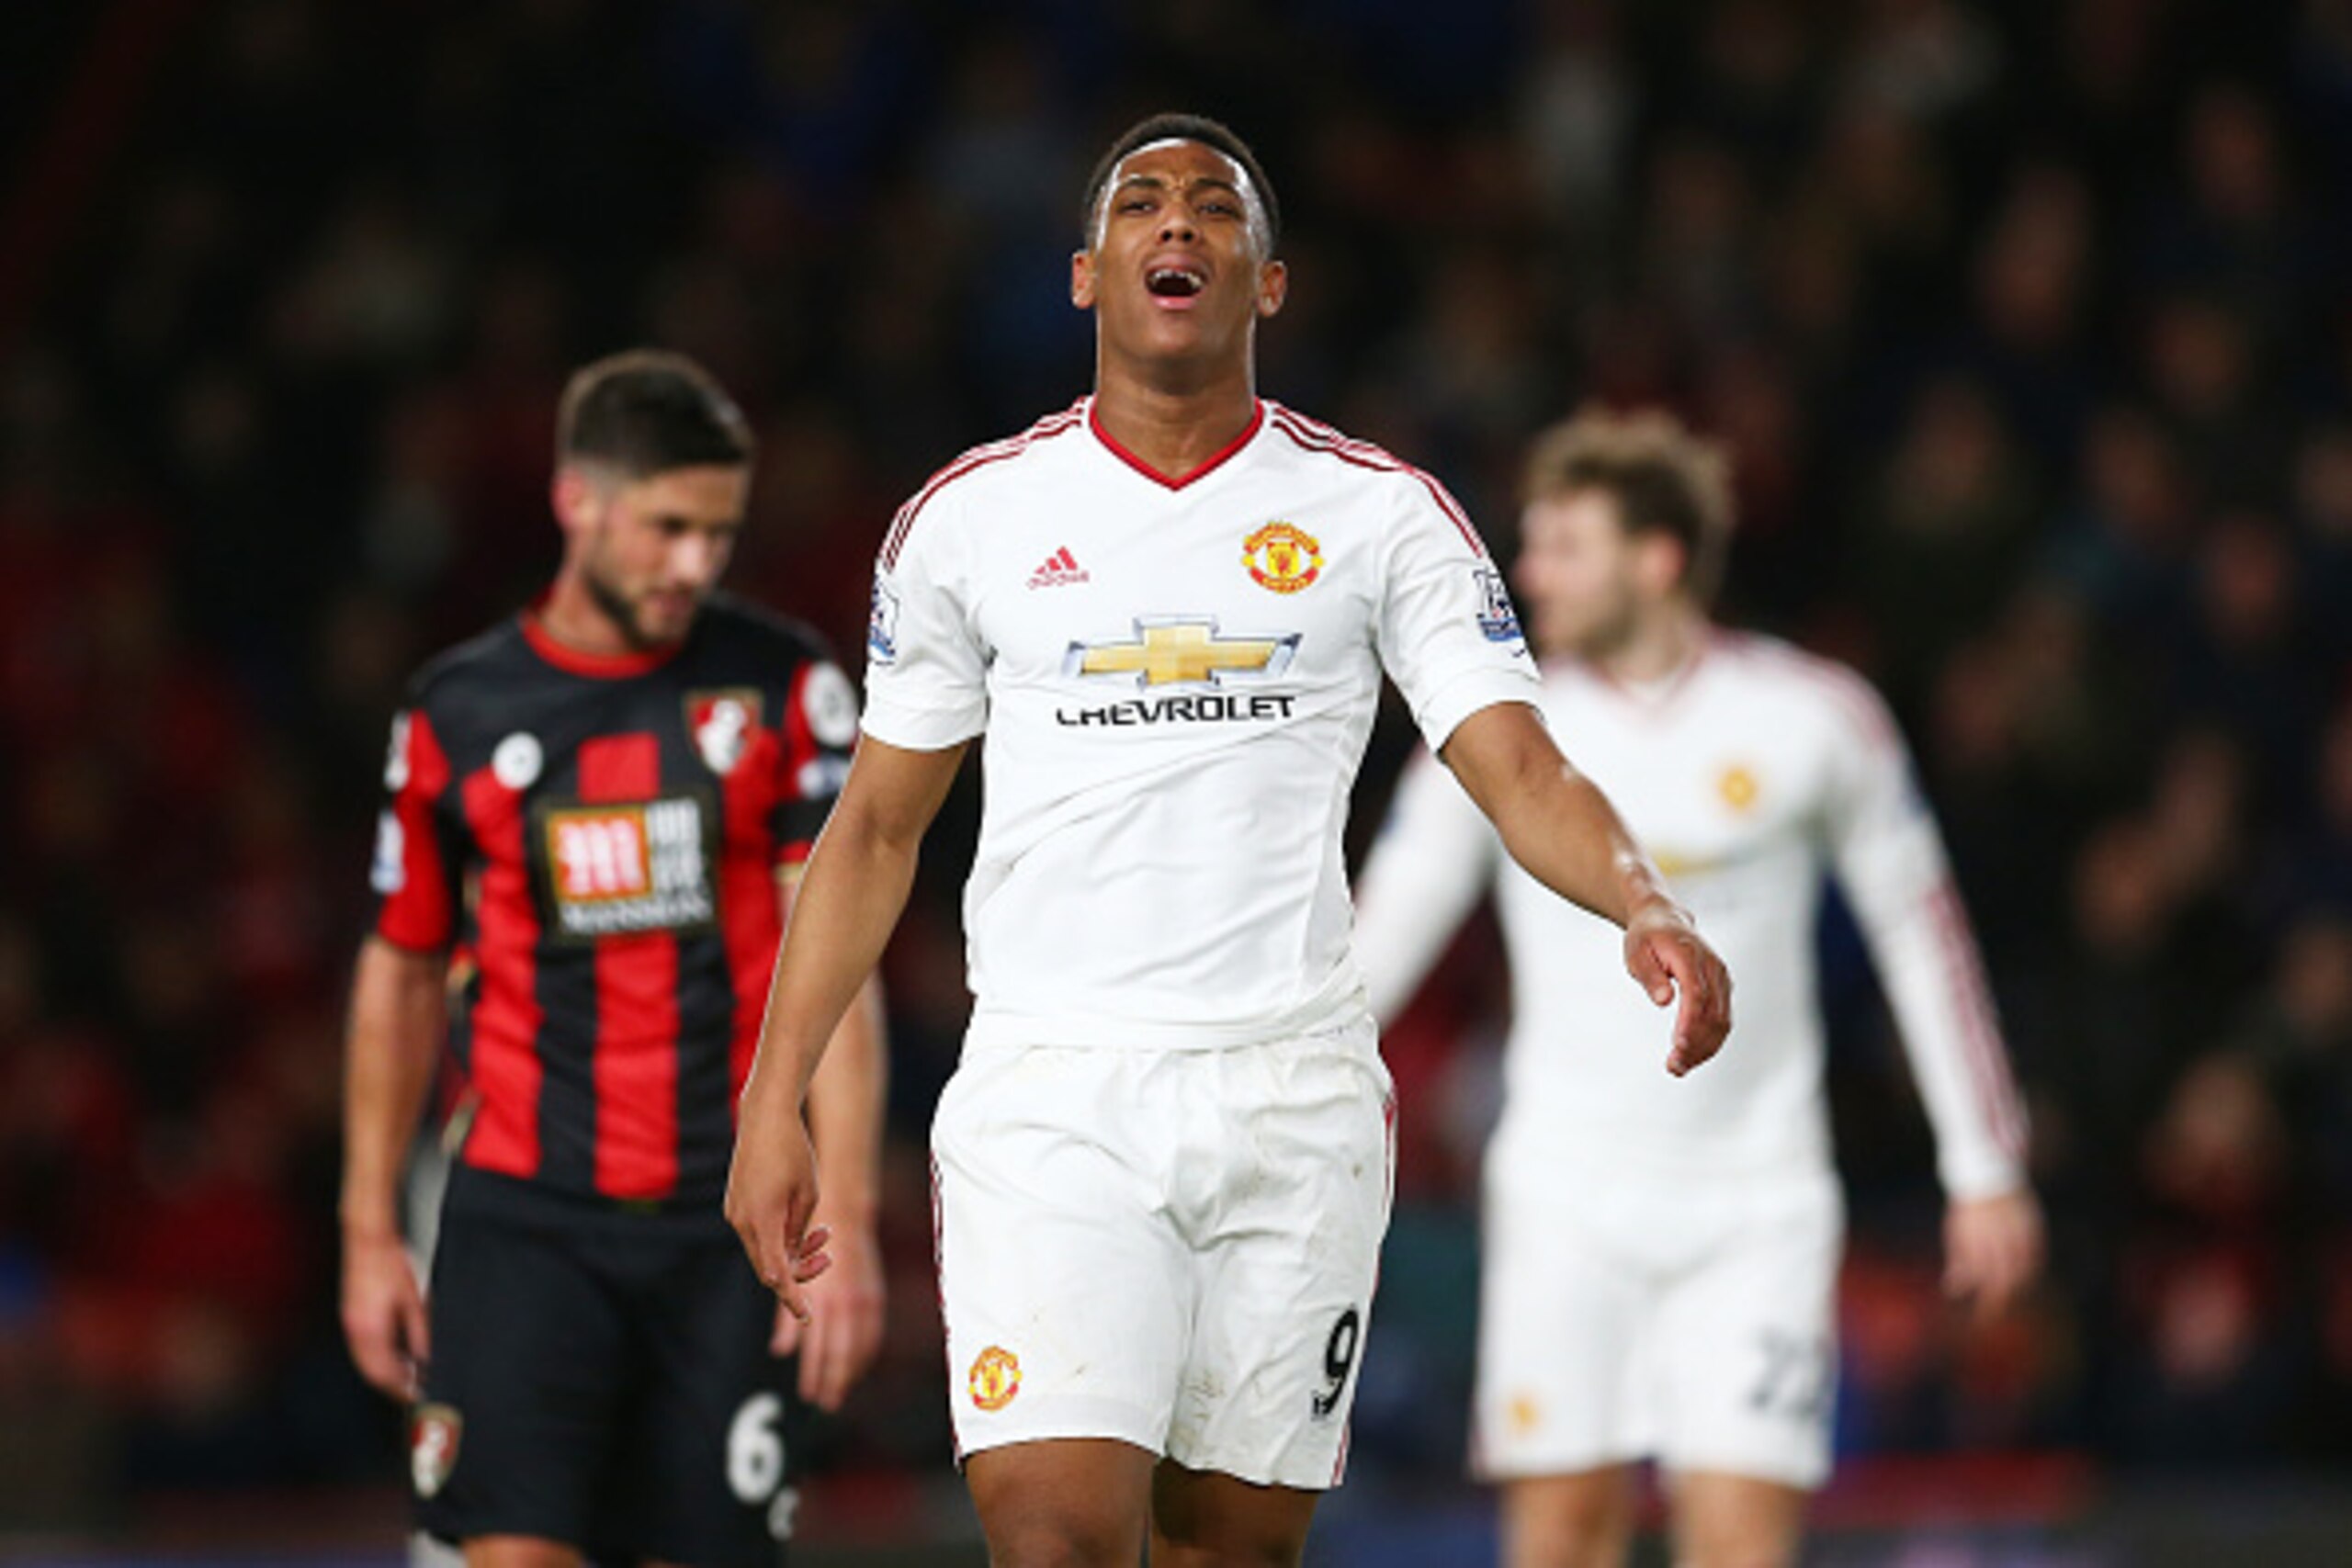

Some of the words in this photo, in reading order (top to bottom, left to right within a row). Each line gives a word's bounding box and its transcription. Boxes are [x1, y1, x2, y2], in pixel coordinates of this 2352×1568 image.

[1056, 695, 1295, 726] CHEVROLET
[1323, 1307, 1359, 1416] 9
[727, 1393, 784, 1505] 6
